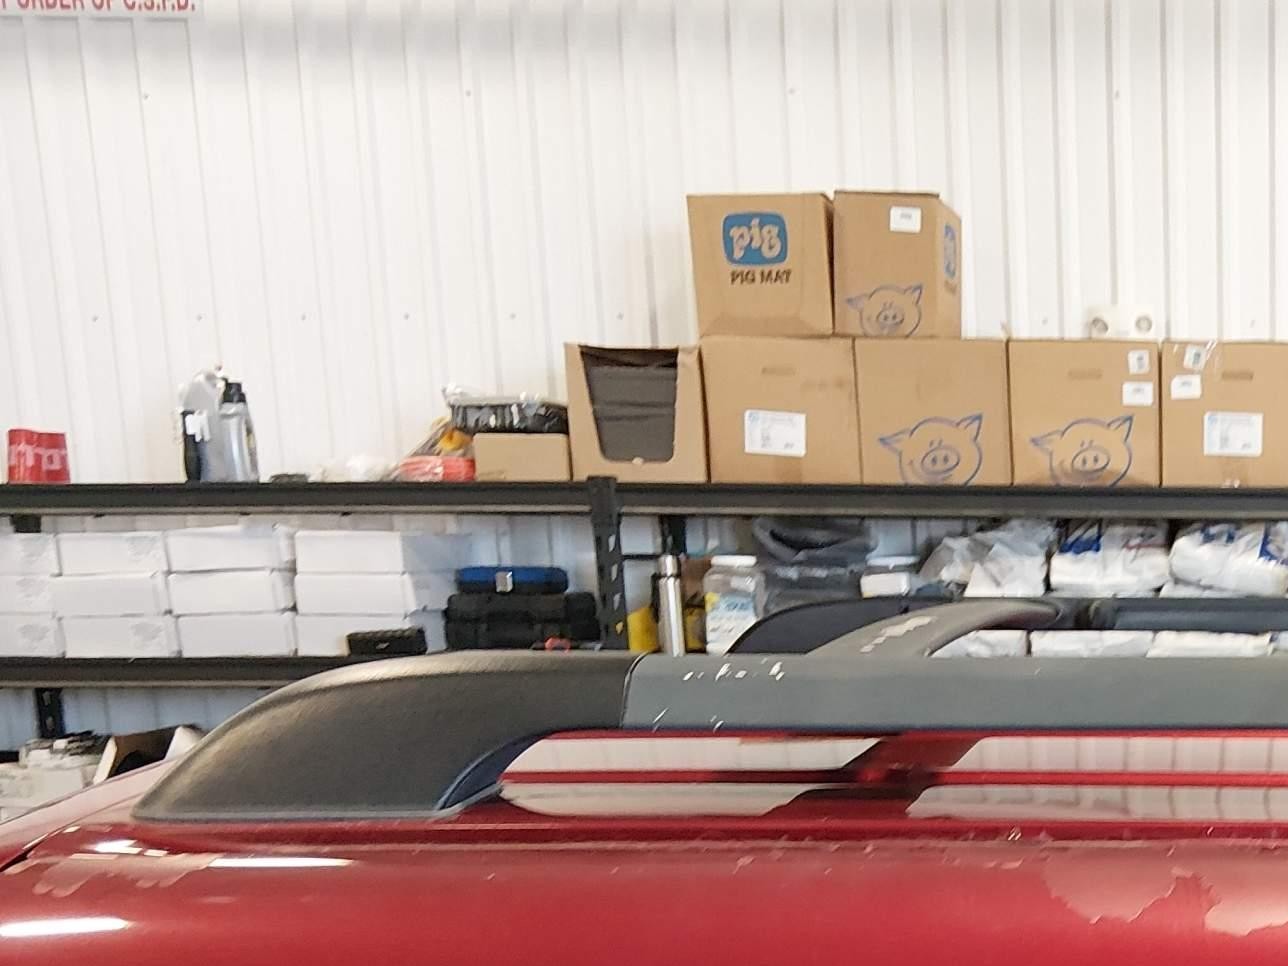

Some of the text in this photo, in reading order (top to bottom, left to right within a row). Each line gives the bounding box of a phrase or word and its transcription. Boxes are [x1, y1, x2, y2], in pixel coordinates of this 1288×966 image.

[729, 217, 782, 261] pig
[730, 268, 792, 285] PIG MAT
